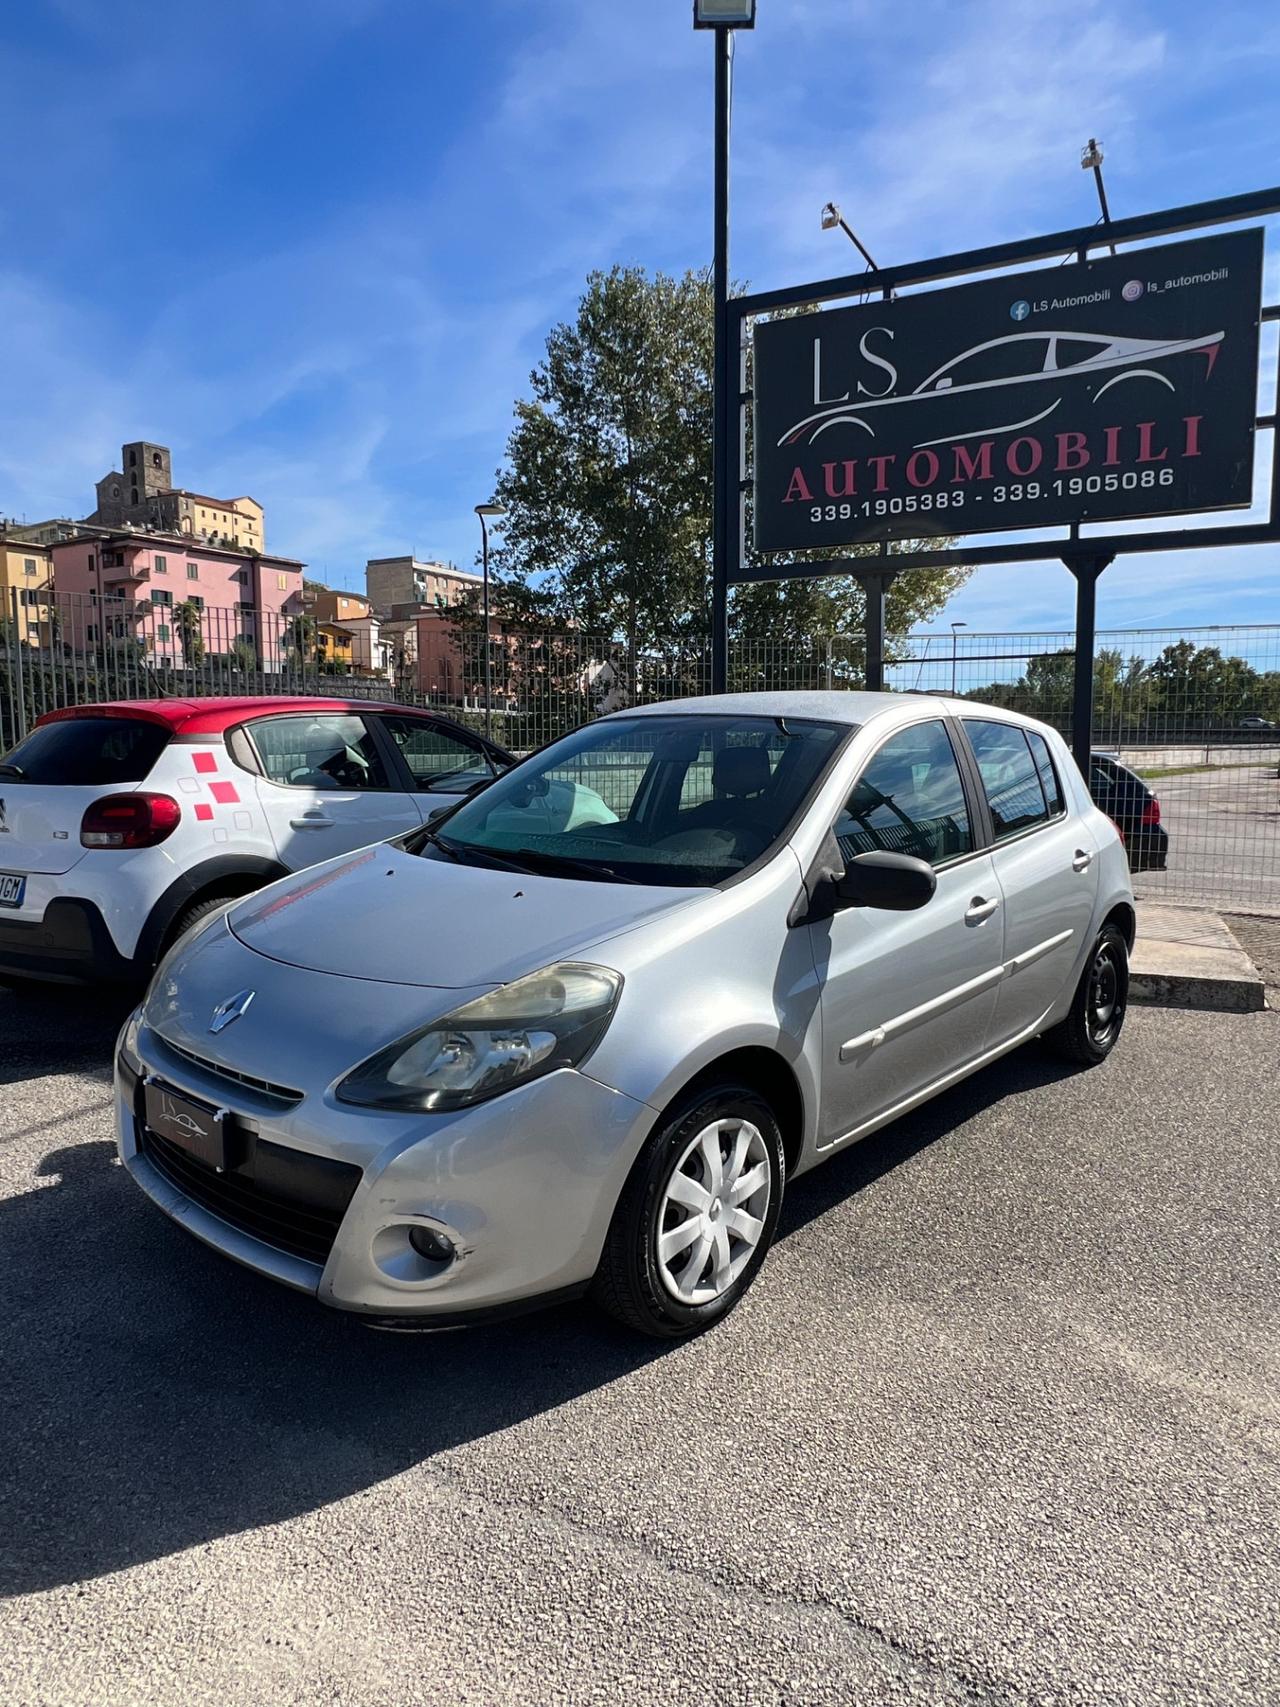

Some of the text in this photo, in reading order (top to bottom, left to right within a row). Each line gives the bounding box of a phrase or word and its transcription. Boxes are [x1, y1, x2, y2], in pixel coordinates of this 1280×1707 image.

[1033, 289, 1111, 312] LS Automobili
[1147, 267, 1229, 294] ls_automobili
[814, 327, 898, 405] LS
[781, 415, 1204, 503] AUTOMOBILI
[810, 490, 965, 522] 339.1905383
[993, 468, 1174, 503] 339.1905086
